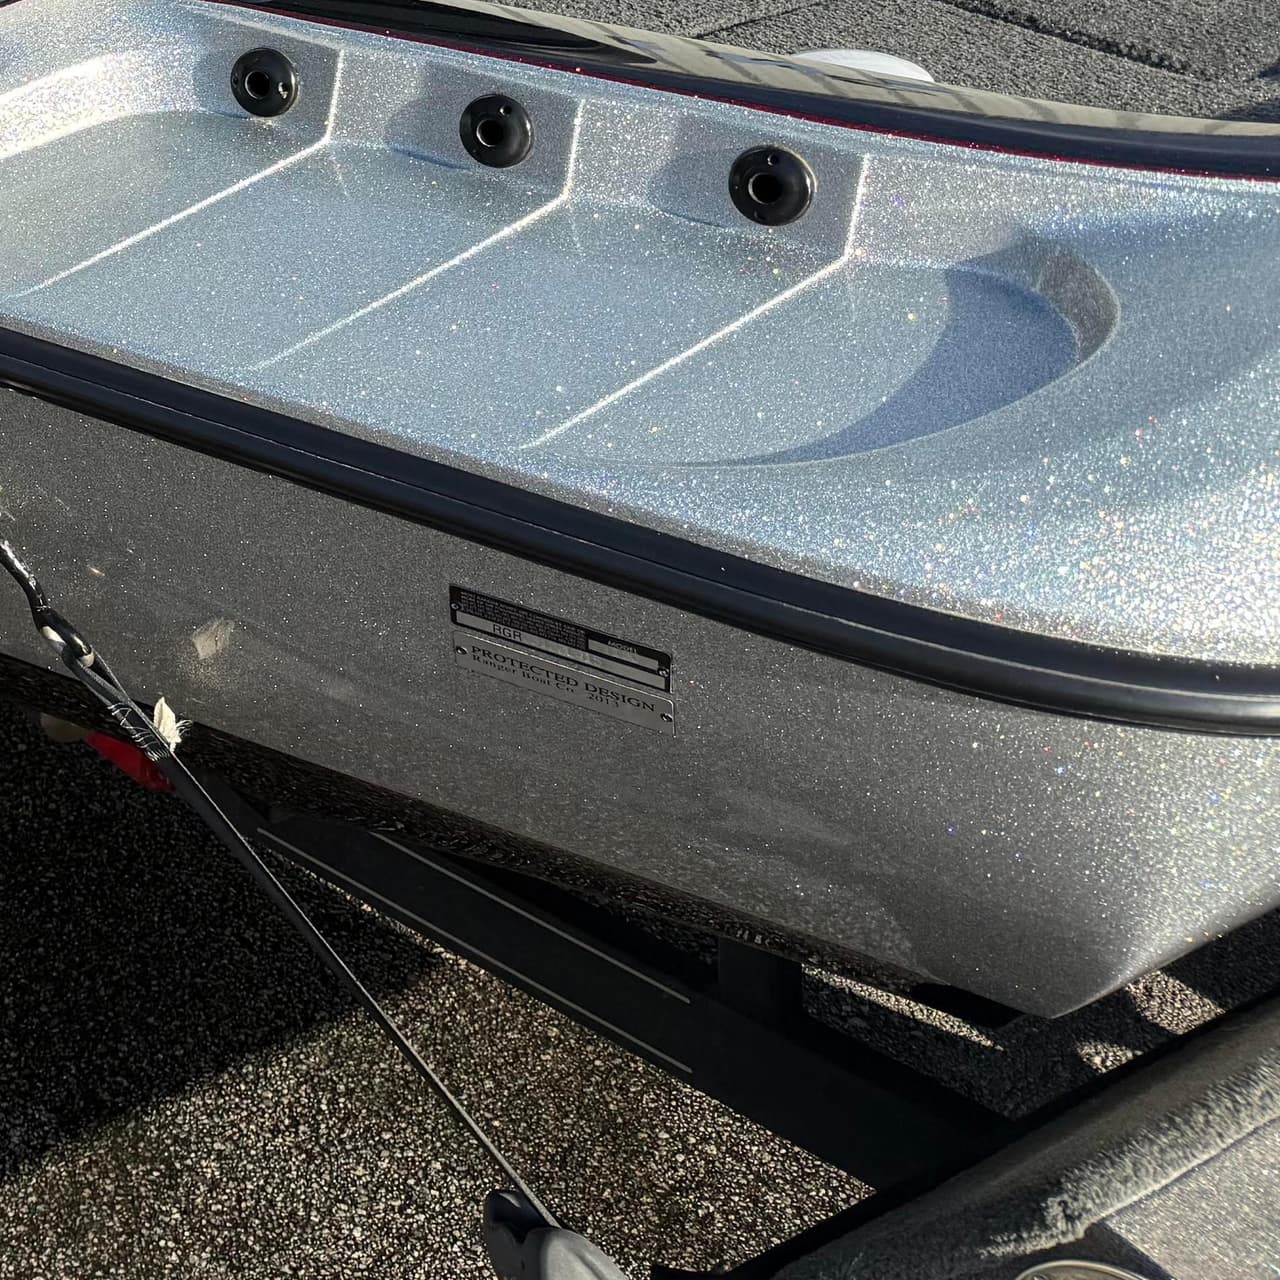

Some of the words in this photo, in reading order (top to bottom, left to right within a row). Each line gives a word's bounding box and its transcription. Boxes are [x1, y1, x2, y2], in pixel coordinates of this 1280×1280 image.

[492, 624, 522, 642] RGR
[471, 645, 579, 687] PROTECTED
[584, 682, 655, 712] DESIGN
